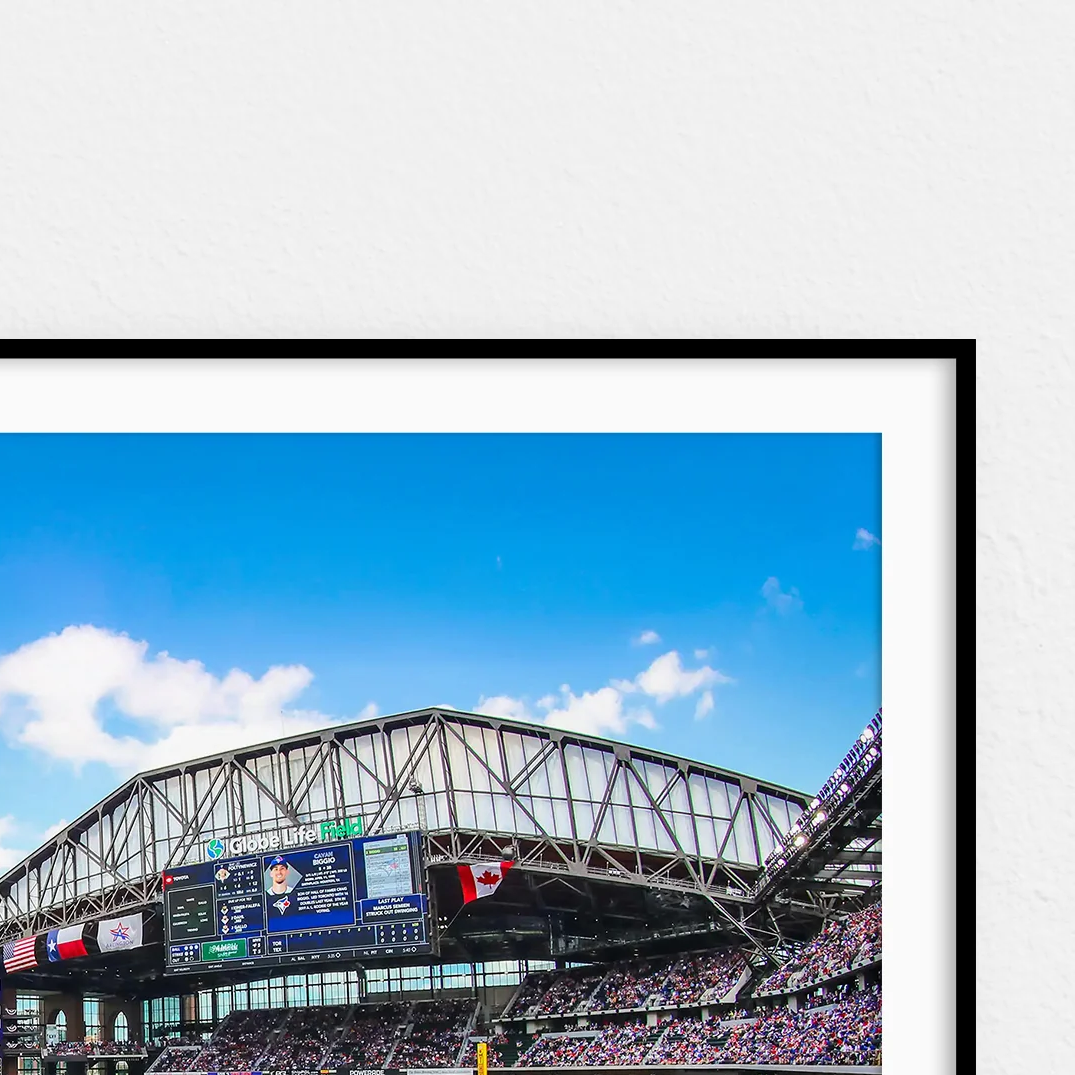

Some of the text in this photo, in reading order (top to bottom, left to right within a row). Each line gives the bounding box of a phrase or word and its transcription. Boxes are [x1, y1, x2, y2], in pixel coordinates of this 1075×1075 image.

[229, 816, 363, 854] Globe Life Field
[312, 857, 336, 866] BIGGIO
